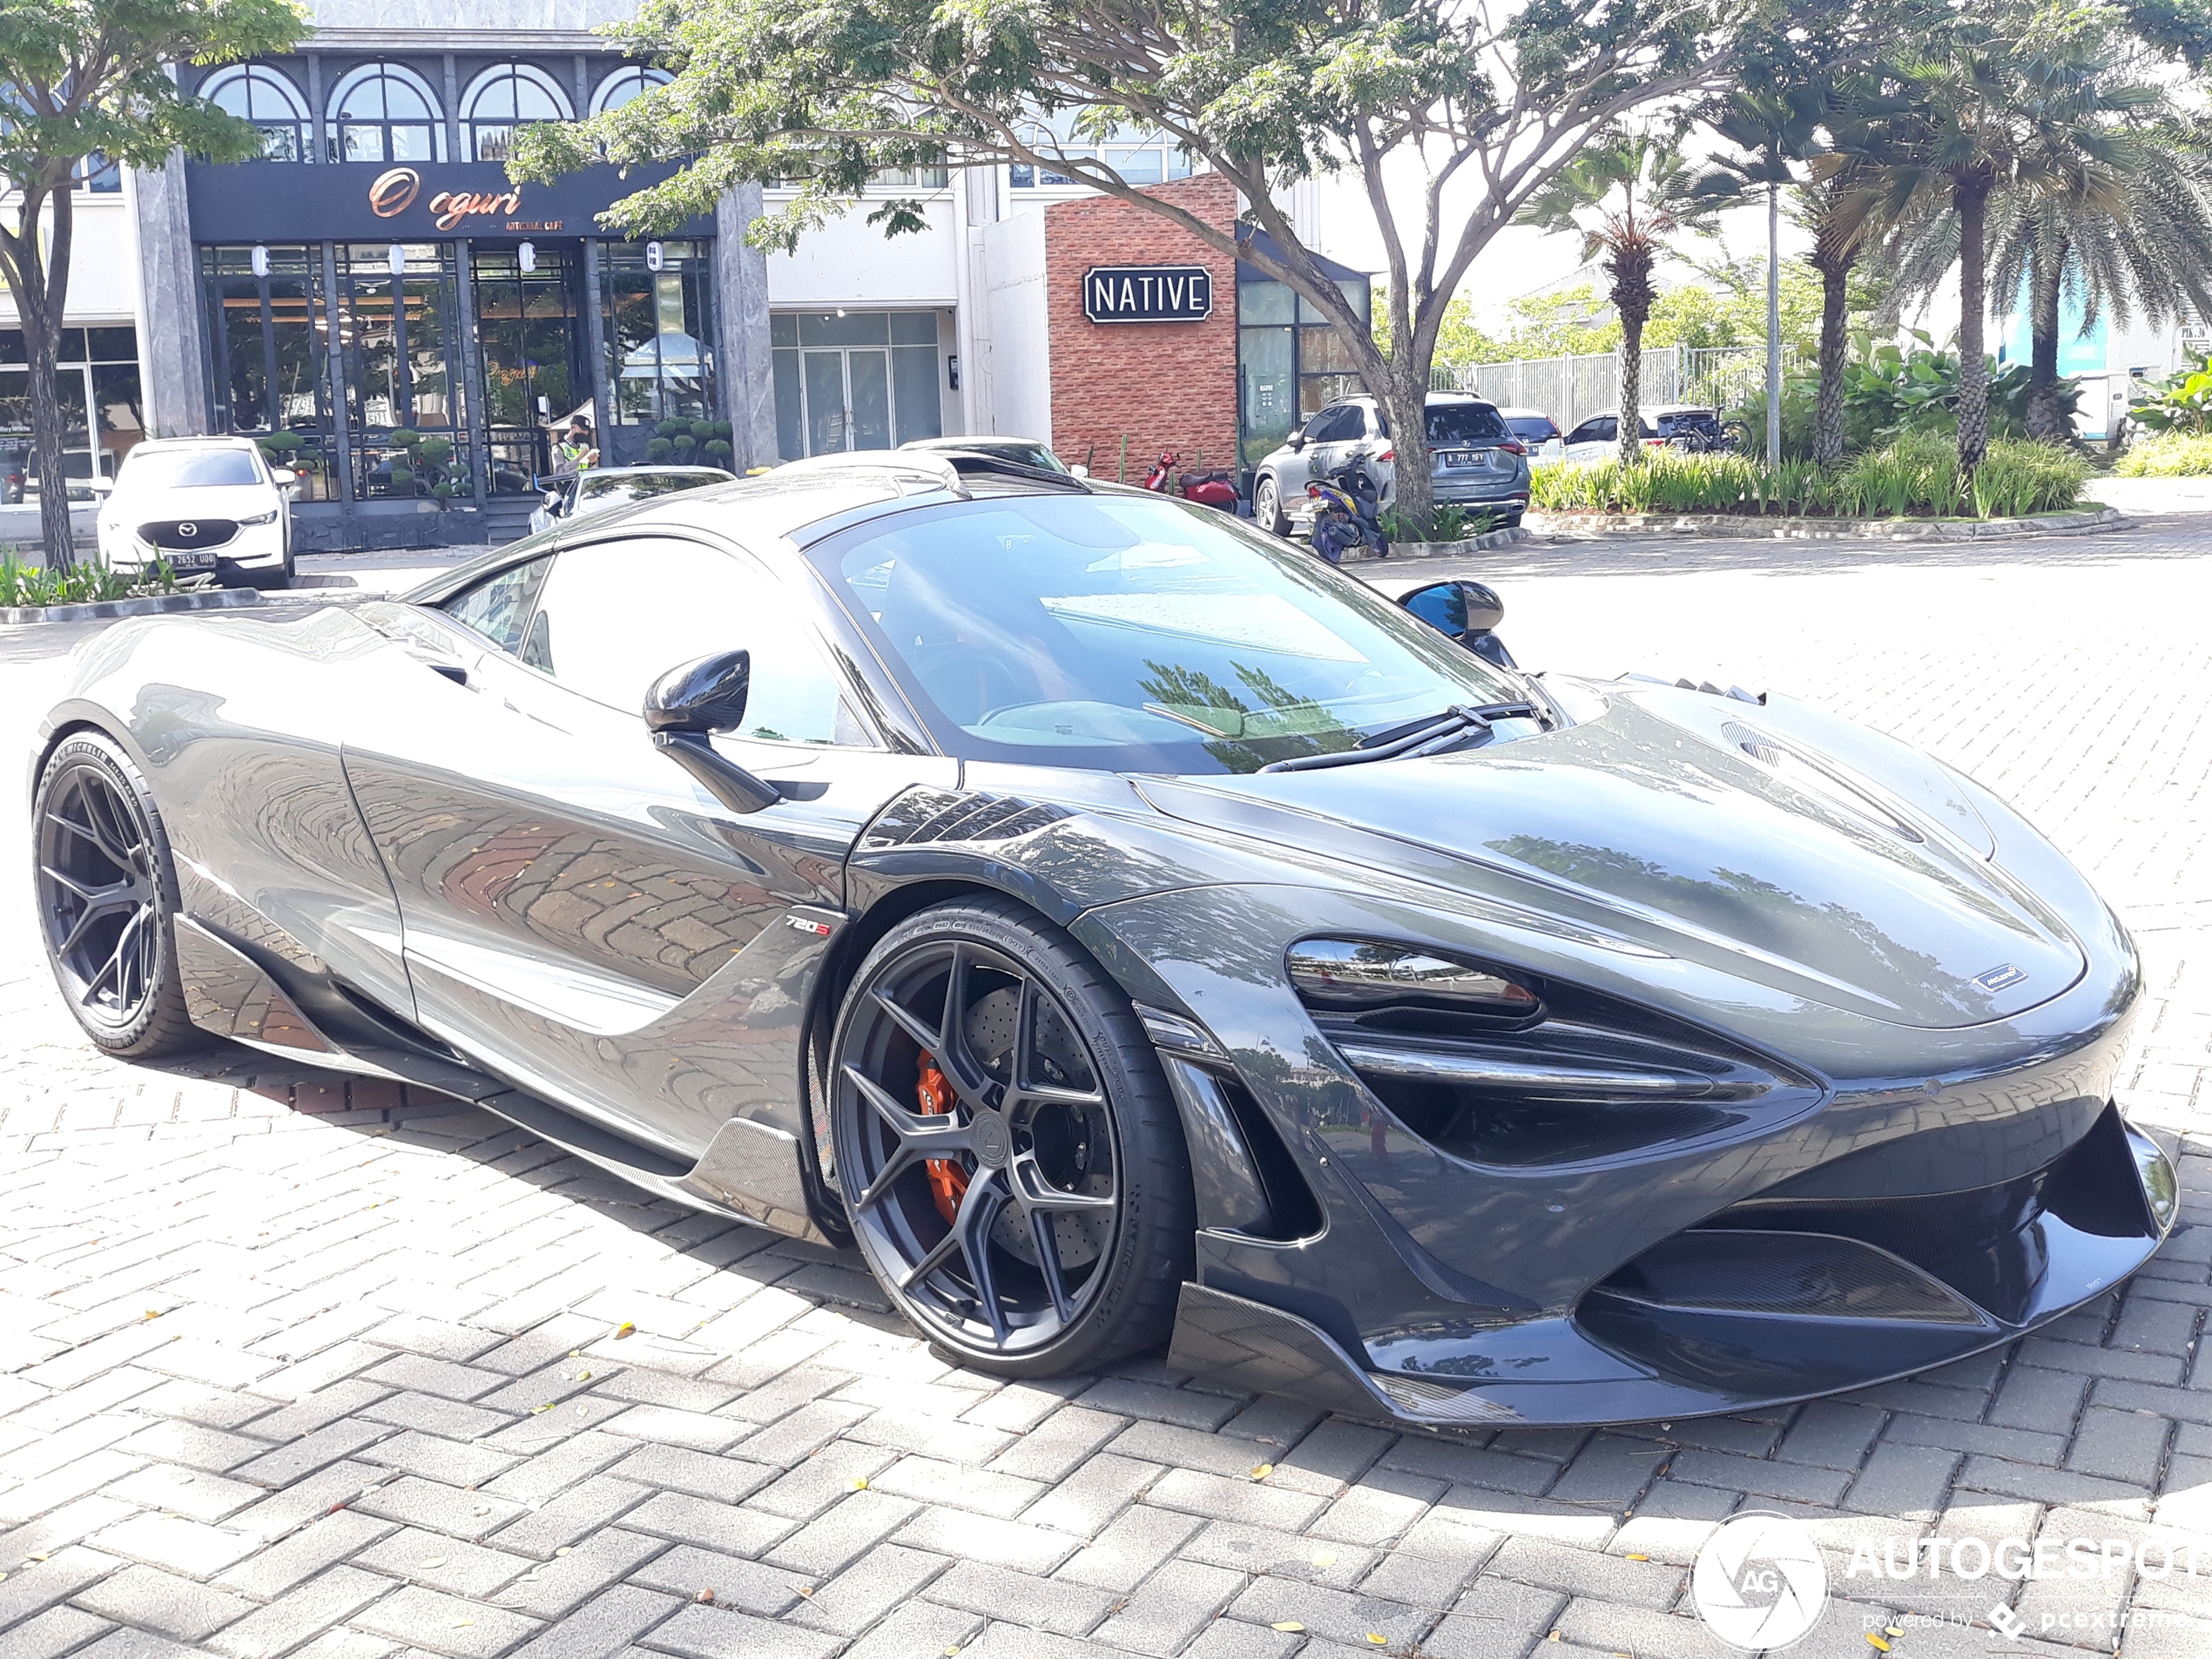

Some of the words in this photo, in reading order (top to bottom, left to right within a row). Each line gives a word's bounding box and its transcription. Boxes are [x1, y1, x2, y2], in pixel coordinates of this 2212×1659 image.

[1095, 276, 1204, 312] NATIVE
[1457, 454, 1469, 462] 777
[168, 556, 173, 565] B
[177, 555, 196, 564] 2652
[66, 742, 108, 763] MICHELIN
[786, 914, 832, 936] 720S
